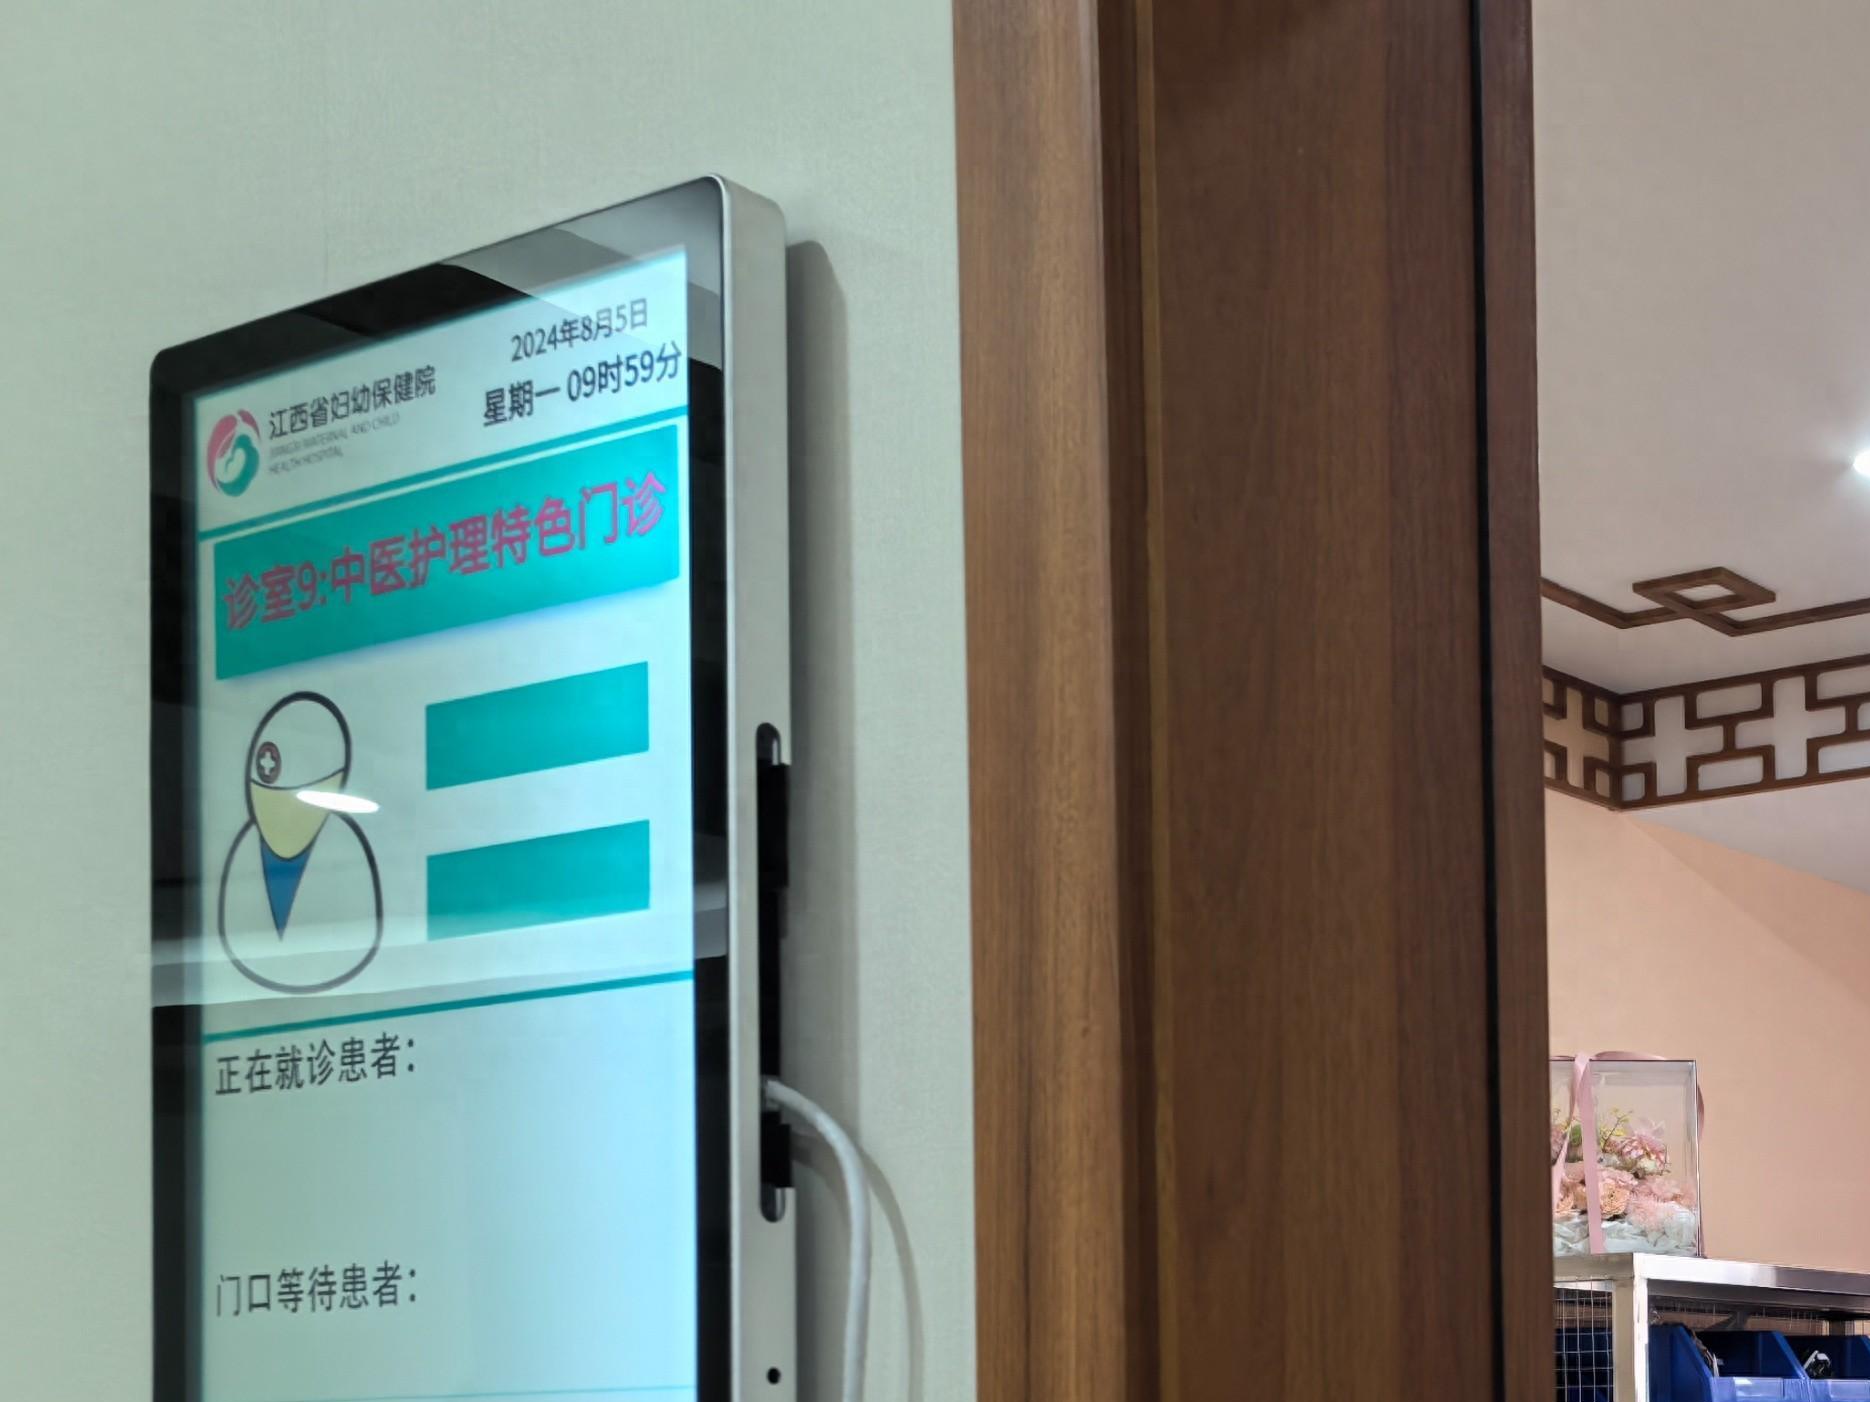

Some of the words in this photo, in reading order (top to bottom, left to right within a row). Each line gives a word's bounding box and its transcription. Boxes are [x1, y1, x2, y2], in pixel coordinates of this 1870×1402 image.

[511, 298, 647, 362] 2024年8月5日
[269, 364, 436, 440] 江西省妇幼保健院
[483, 379, 561, 427] 星期一
[567, 340, 682, 402] 09时59分
